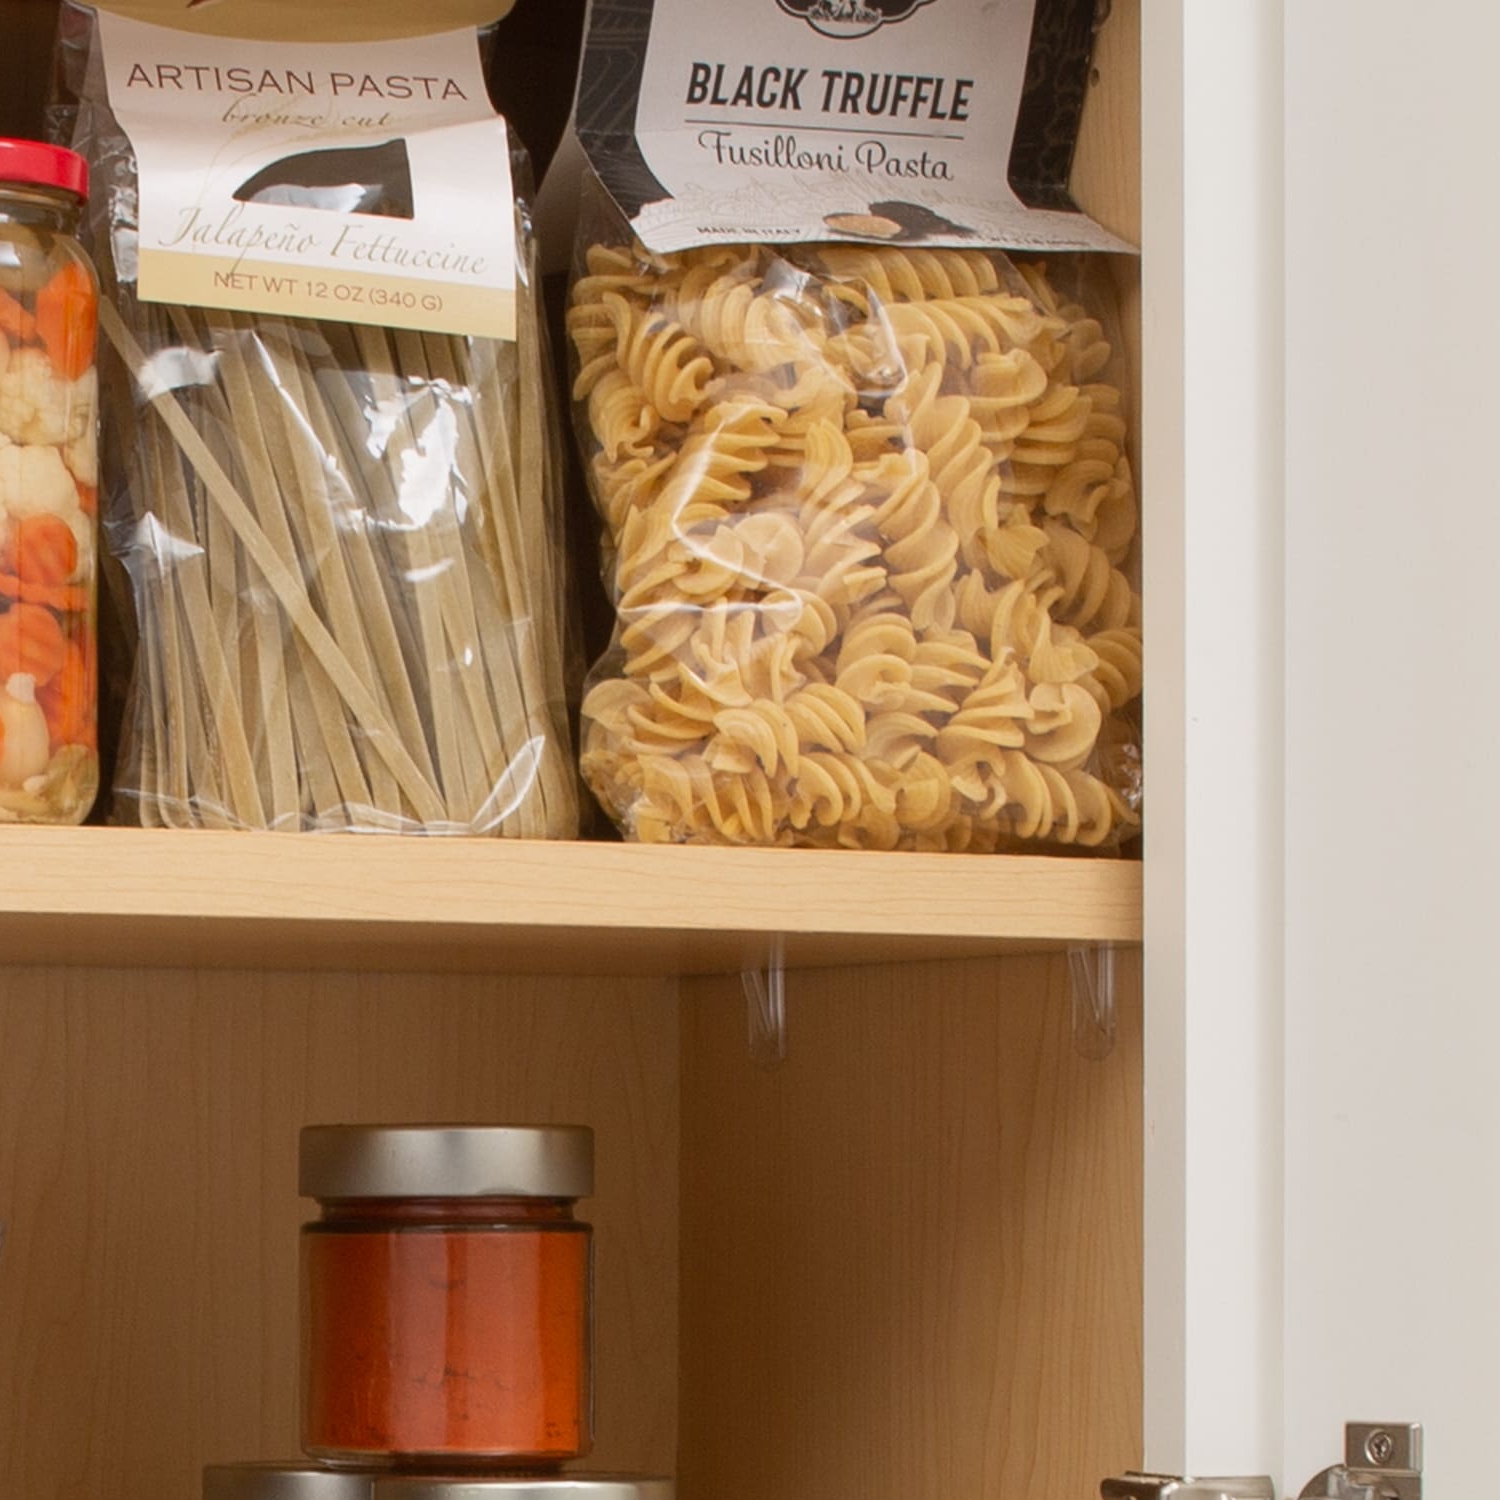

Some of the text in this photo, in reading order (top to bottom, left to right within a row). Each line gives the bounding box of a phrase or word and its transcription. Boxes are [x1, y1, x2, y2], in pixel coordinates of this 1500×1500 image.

[126, 63, 468, 101] ARTISAN PASTA
[685, 62, 975, 122] BLACK TRUFFLE
[221, 98, 393, 129] bronze cut
[697, 130, 955, 182] Fusilloni Pasta
[158, 202, 490, 277] Jalapeño Fettuccine
[213, 271, 444, 313] NET WT 12 OZ (340 G)
